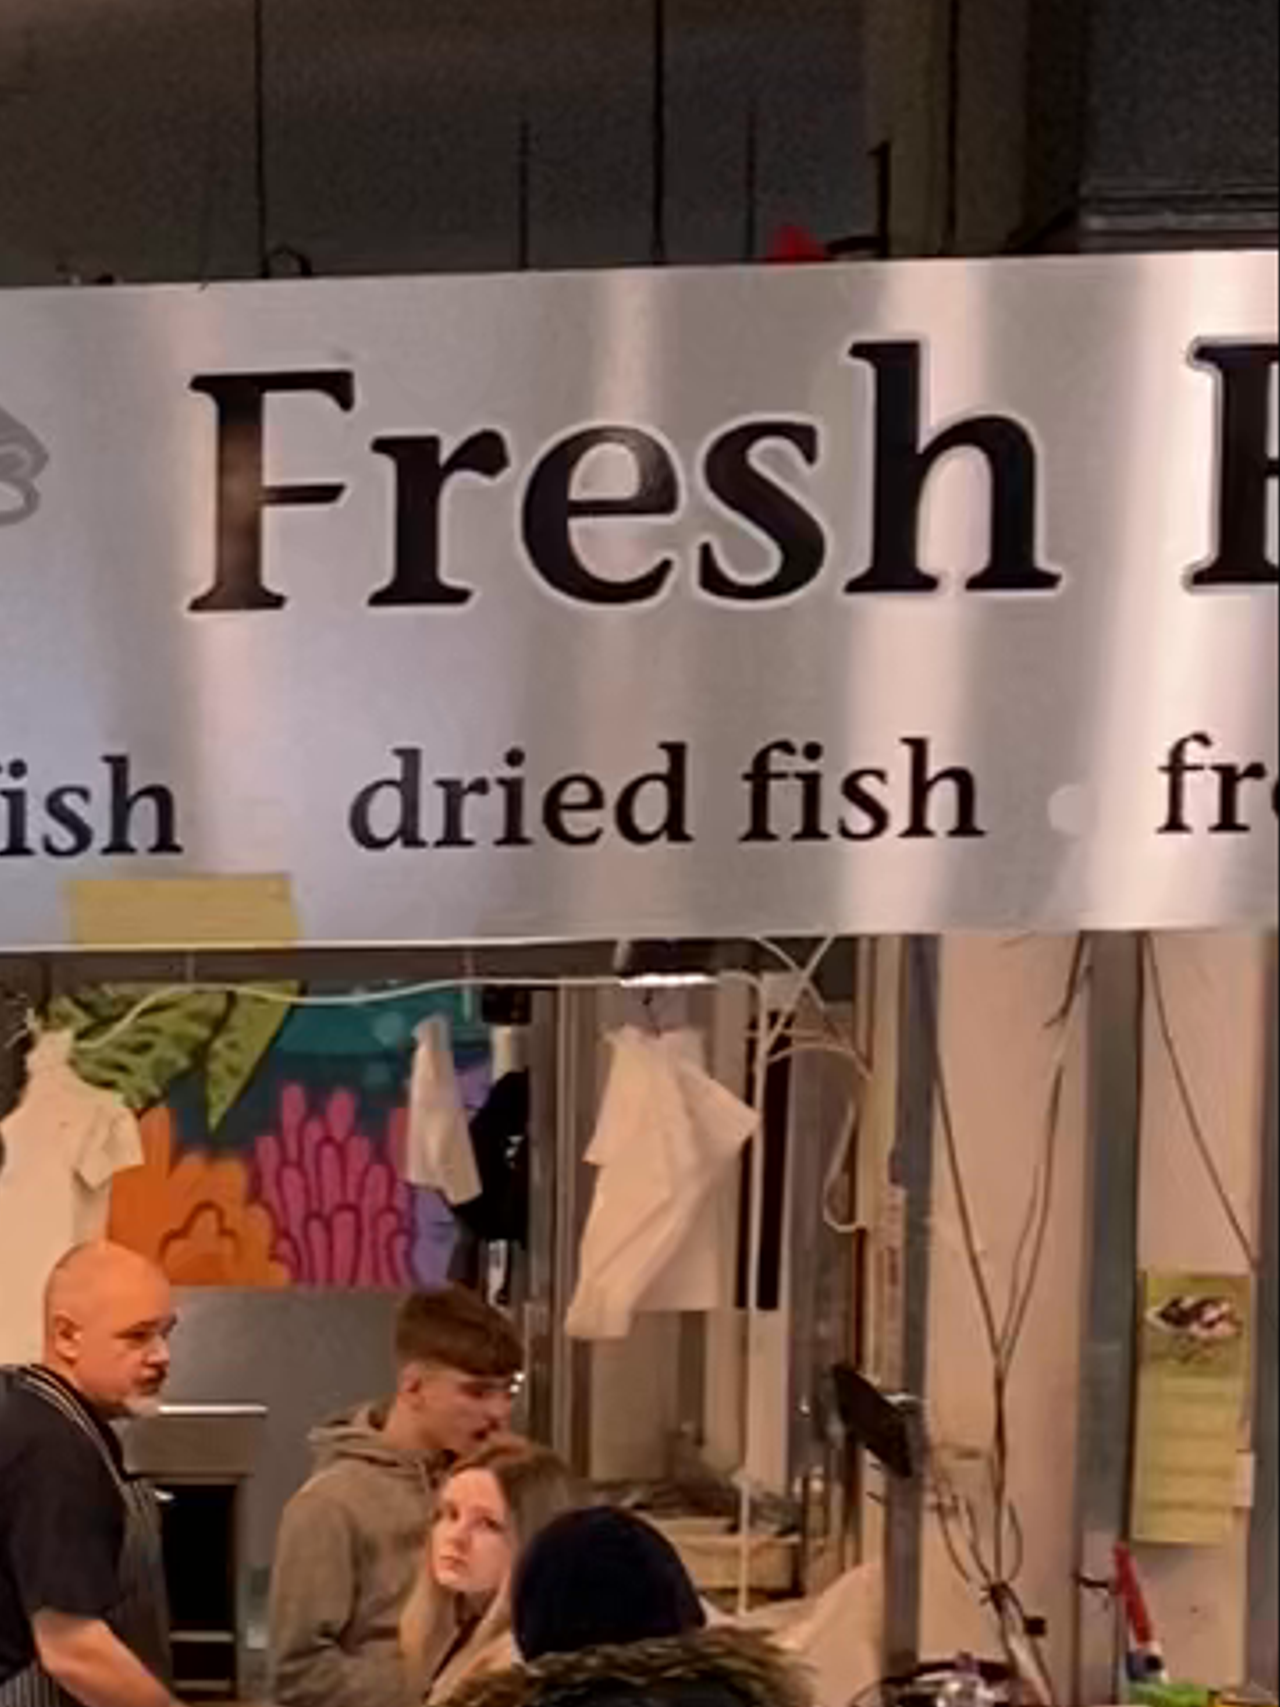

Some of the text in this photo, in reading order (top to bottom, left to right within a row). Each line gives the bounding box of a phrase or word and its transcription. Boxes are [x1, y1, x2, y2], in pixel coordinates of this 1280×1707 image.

[188, 340, 1062, 613] Fresh
[348, 736, 987, 851] dried fish
[1157, 732, 1278, 834] fr
